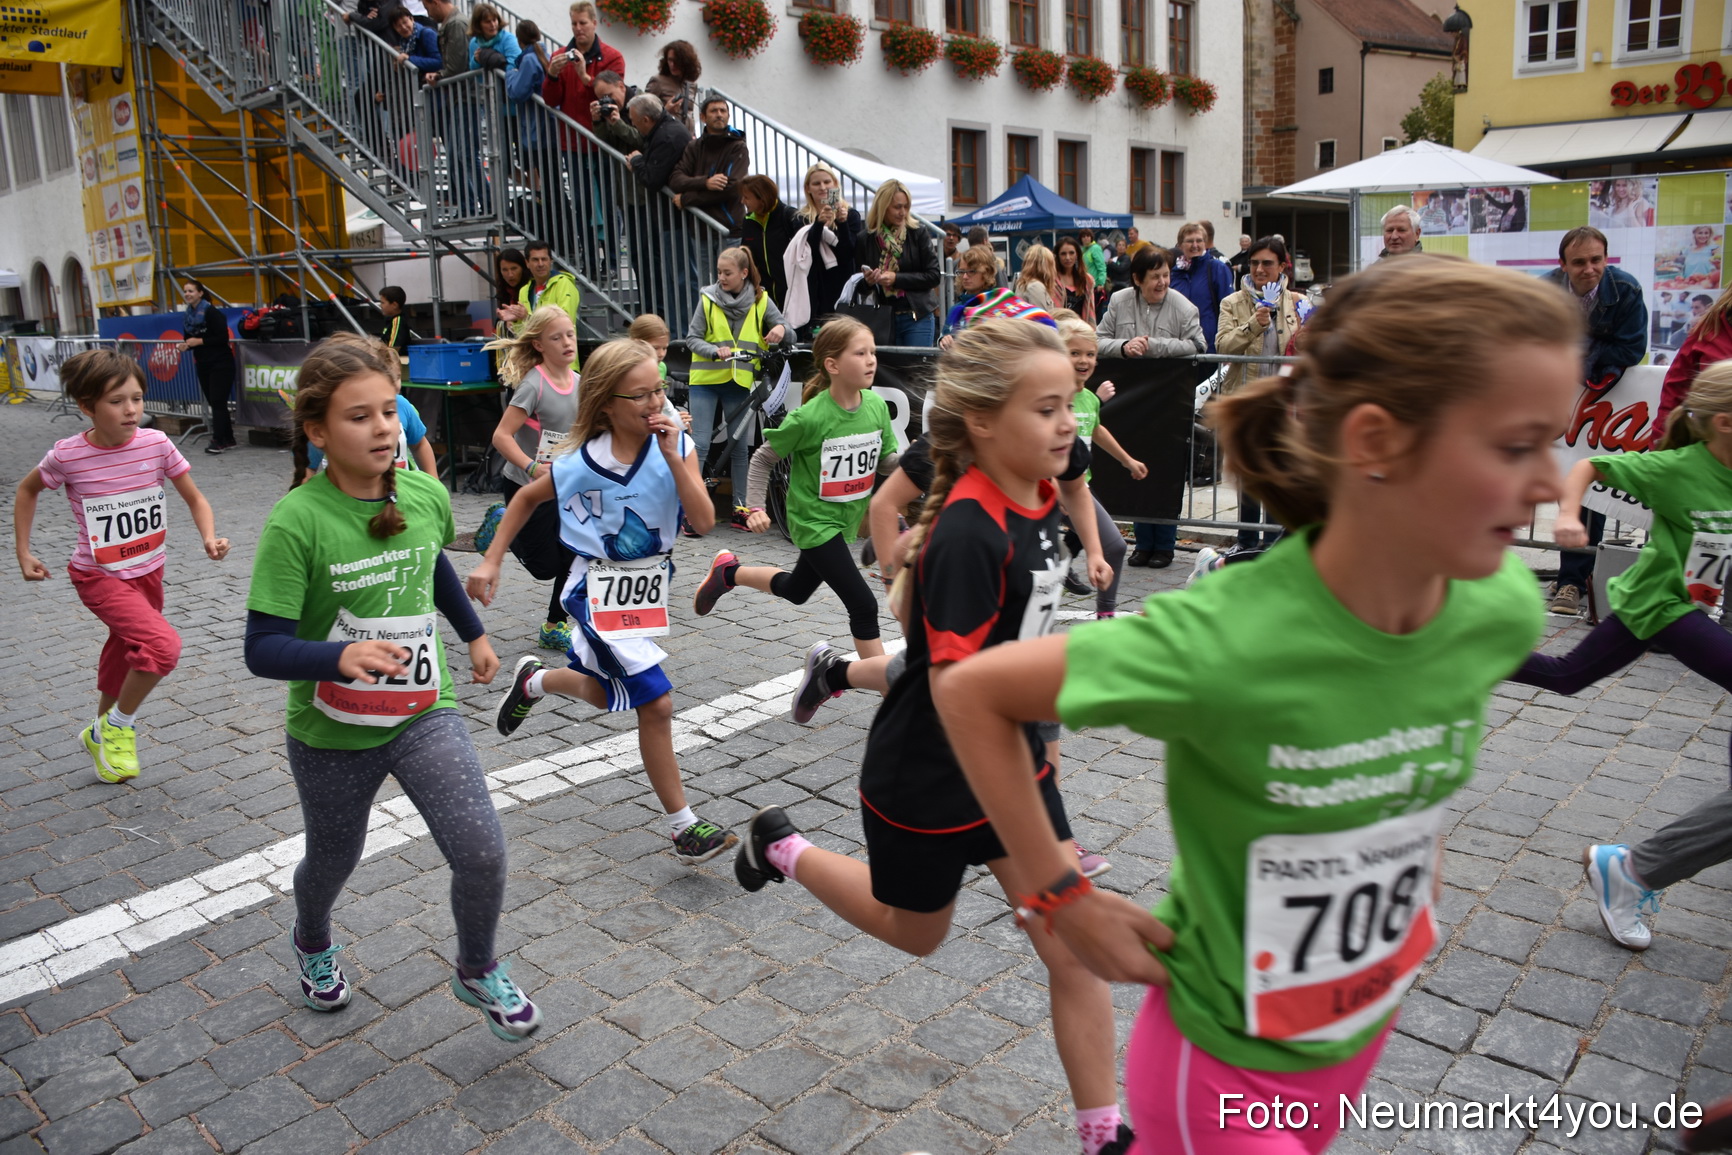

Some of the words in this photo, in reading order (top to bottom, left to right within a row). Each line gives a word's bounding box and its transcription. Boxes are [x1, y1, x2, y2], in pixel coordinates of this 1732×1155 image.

[30, 25, 88, 39] Stadtlauf
[1610, 80, 1670, 107] Der
[1674, 61, 1732, 109] B
[992, 220, 1023, 232] Tagblatt
[823, 444, 847, 453] PARTL
[848, 440, 875, 450] Neumarkt
[830, 448, 877, 478] 7196
[844, 481, 865, 493] Carla
[86, 503, 117, 513] PARTL
[117, 495, 156, 509] Neumarkt
[96, 504, 162, 543] 7066
[120, 542, 150, 558] Emma
[329, 548, 411, 576] Neumarkter
[588, 564, 619, 573] PARTL
[332, 567, 398, 593] Stadtlauf
[598, 574, 662, 606] 7098
[336, 619, 374, 640] PARTL
[622, 614, 641, 626] Ella
[1267, 724, 1448, 769] Neumarkter
[1258, 857, 1352, 880] PARTL
